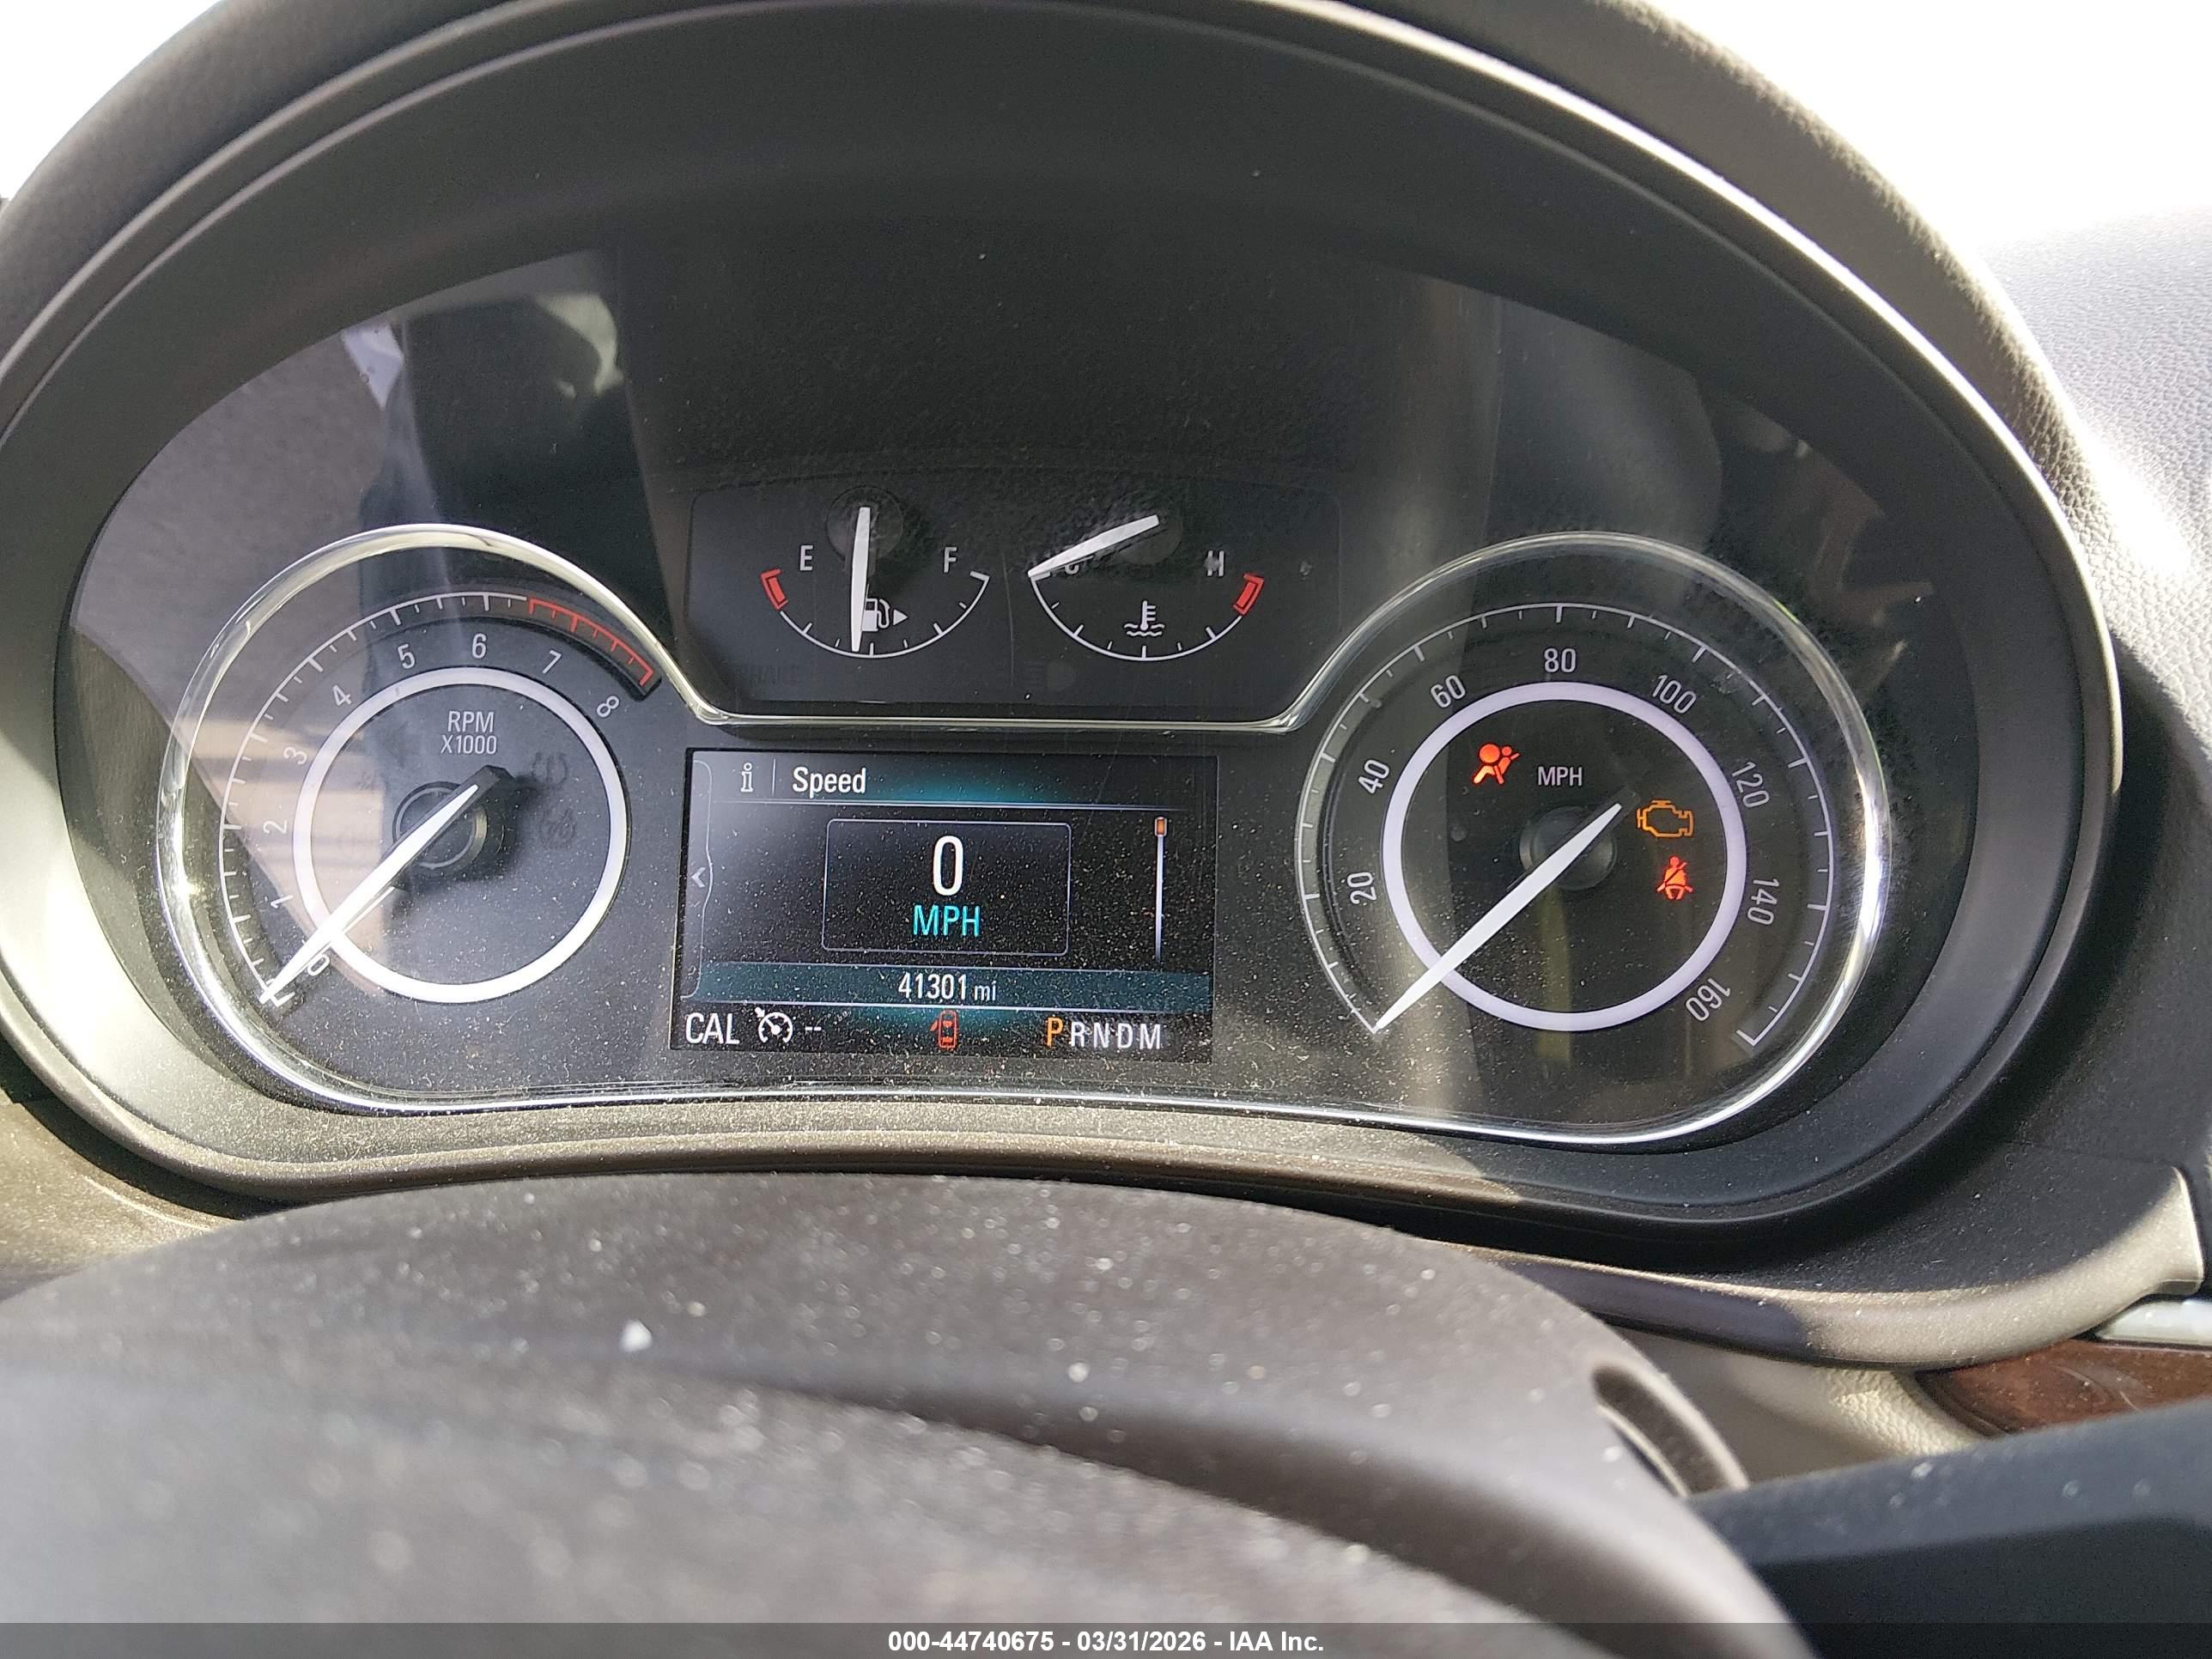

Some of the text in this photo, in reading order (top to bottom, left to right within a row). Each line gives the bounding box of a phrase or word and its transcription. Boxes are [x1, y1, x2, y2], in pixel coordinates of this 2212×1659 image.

[799, 544, 813, 571] E
[945, 546, 957, 572] F
[1206, 550, 1224, 577] H
[398, 644, 415, 670] 5
[471, 633, 487, 659] 6
[542, 650, 562, 674] 7
[1543, 647, 1577, 673] 80
[331, 684, 352, 708] 4
[1429, 674, 1467, 708] 60
[1650, 674, 1698, 714] 100
[596, 695, 620, 718] 8
[447, 710, 495, 732] RPM
[283, 746, 308, 766] 3
[441, 734, 496, 755] X1000
[792, 767, 867, 796] Speed
[1357, 759, 1391, 795] 40
[1537, 766, 1583, 787] MPH
[1730, 761, 1771, 809] 120
[263, 818, 289, 836] 2
[932, 835, 965, 897] 0
[270, 894, 294, 908] 1
[1346, 870, 1377, 905] 20
[1745, 878, 1780, 927] 140
[912, 905, 981, 938] MPH
[898, 972, 998, 1002] 41301 mi
[1685, 976, 1731, 1022] 160
[684, 1012, 740, 1046] CAL
